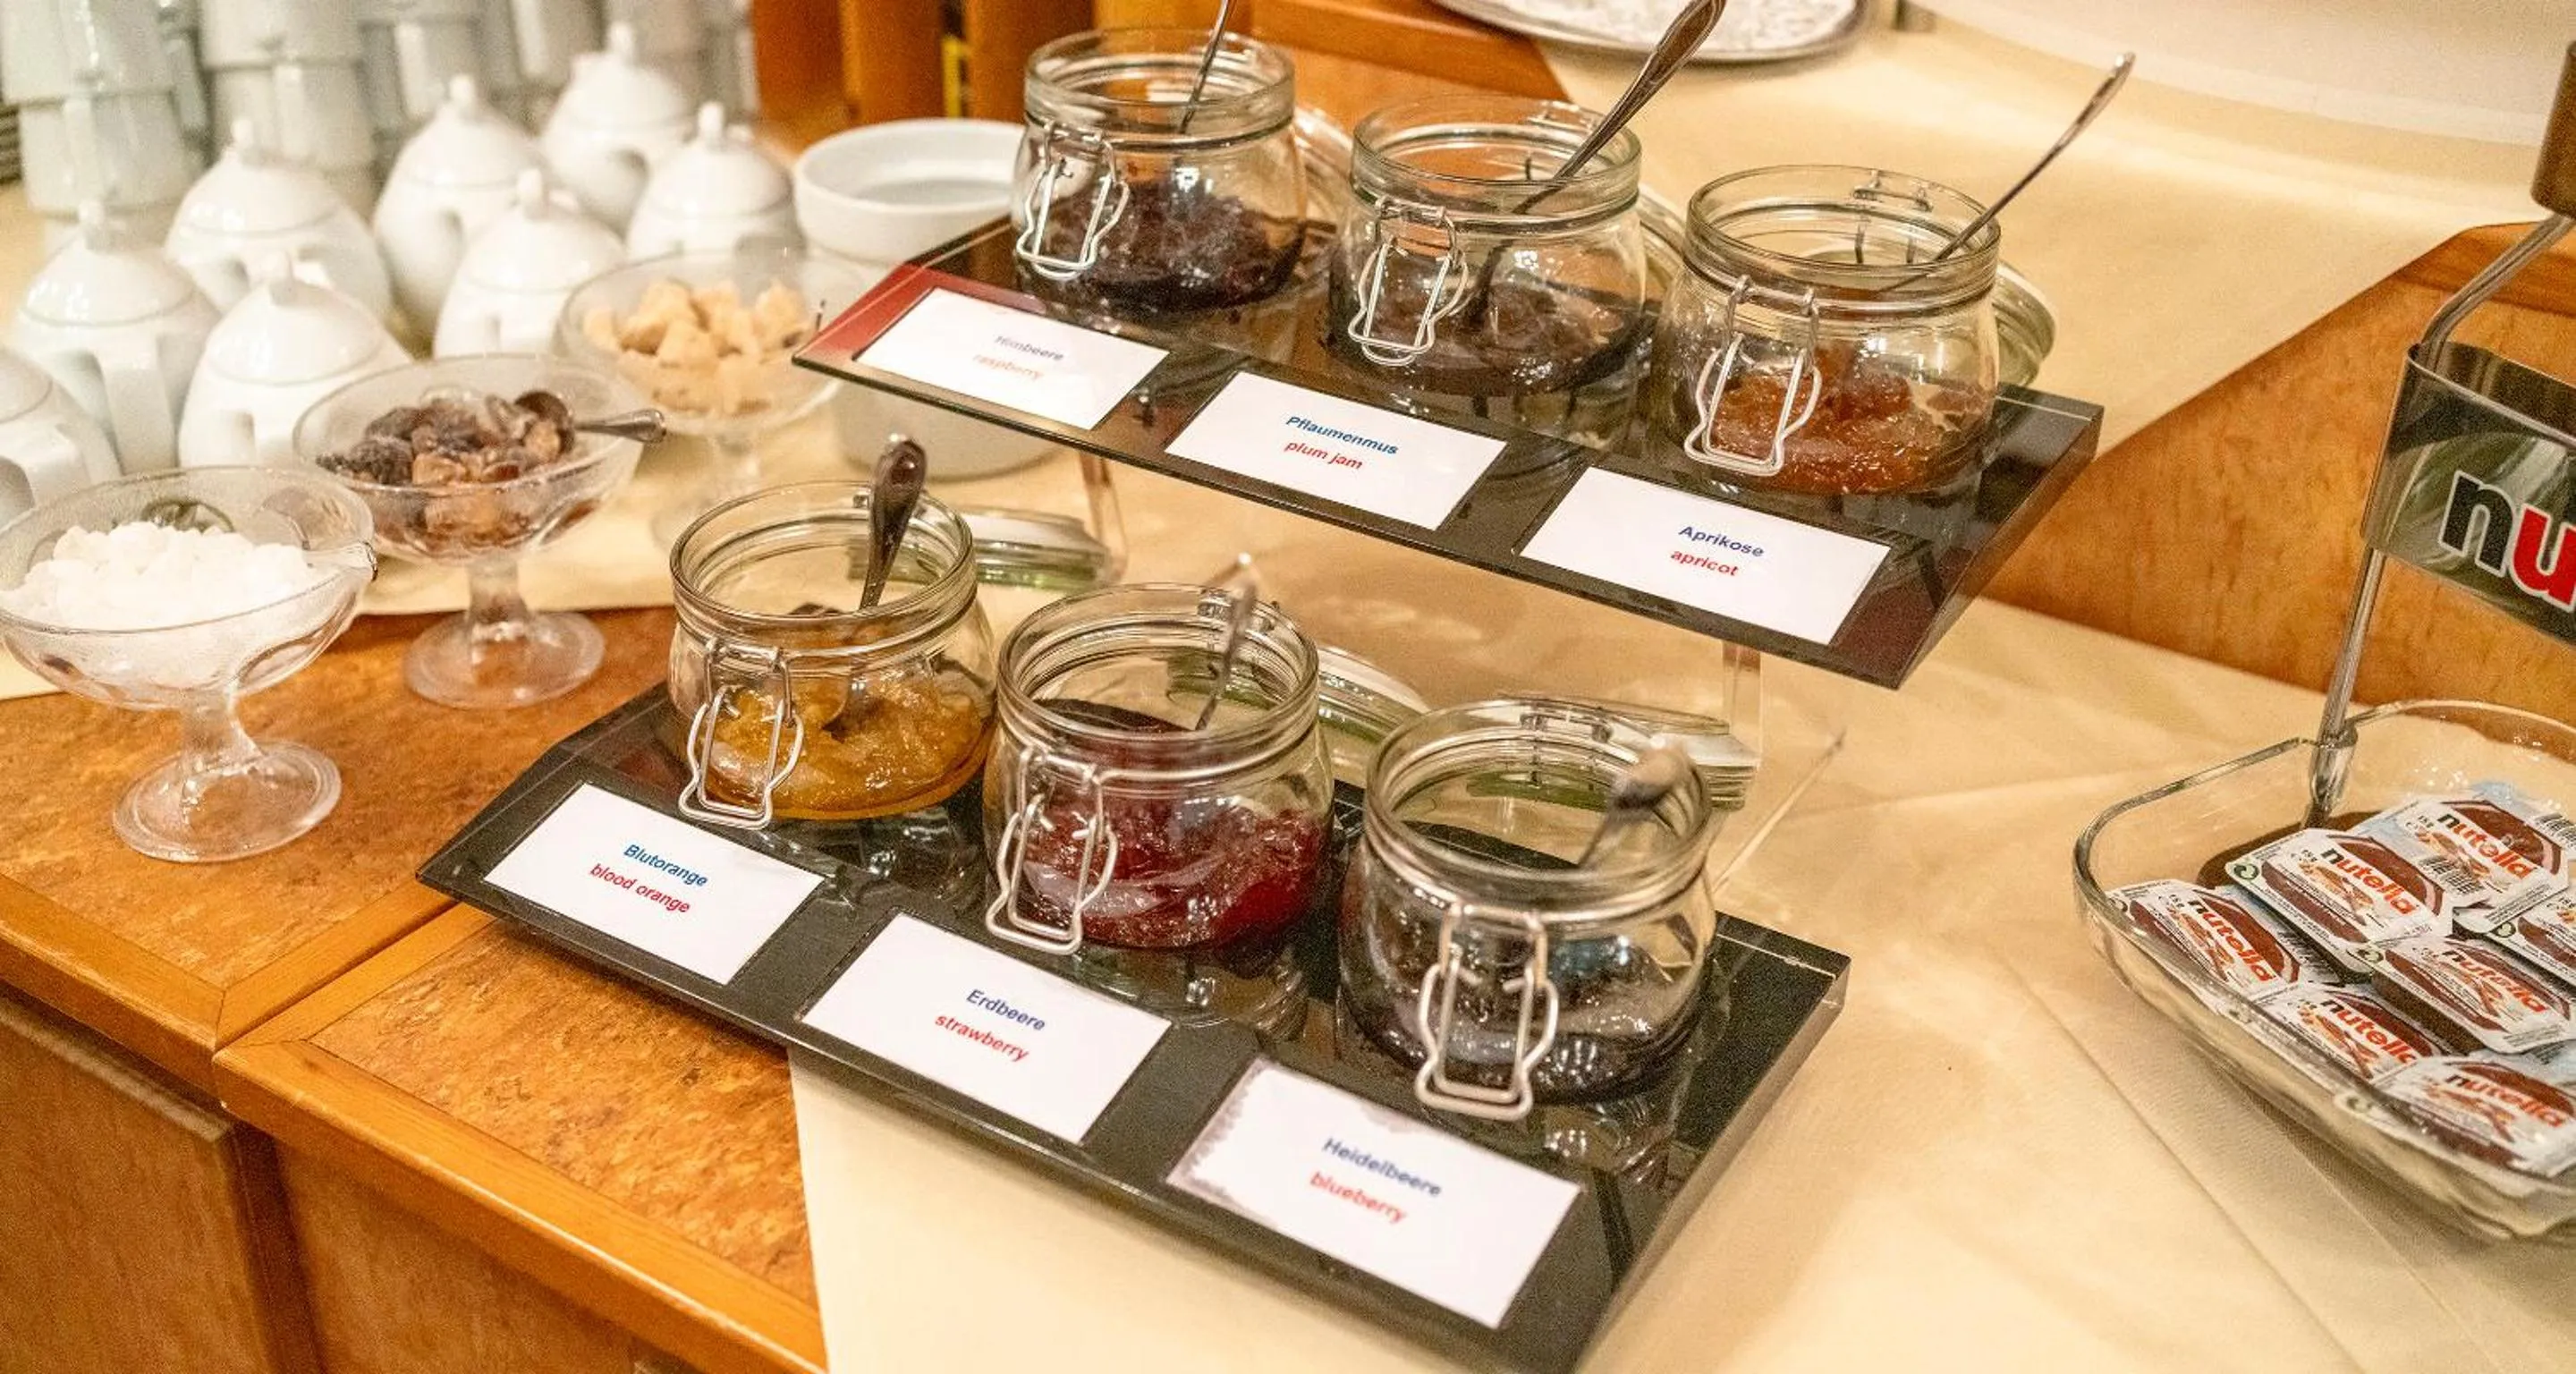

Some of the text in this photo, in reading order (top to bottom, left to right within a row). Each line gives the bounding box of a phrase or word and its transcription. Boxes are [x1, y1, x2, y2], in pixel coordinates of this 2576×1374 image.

[972, 354, 1045, 382] raspberry
[994, 335, 1064, 361] Himbeere
[1284, 442, 1363, 470] plum jam
[1285, 415, 1400, 454] Pflaumenmus
[1670, 550, 1739, 576] apricot
[1678, 525, 1765, 558] Aprikose
[623, 844, 708, 886] Blutorange
[2436, 813, 2533, 879] nutella
[589, 863, 691, 913] blood orange
[2320, 847, 2416, 916] nutella
[2188, 899, 2276, 982] nutella
[2442, 949, 2548, 1014] nutella
[965, 988, 1046, 1032] Erdbeere
[934, 1013, 1030, 1064] strawberry
[2445, 1074, 2567, 1128] nutella
[1322, 1137, 1443, 1197] Heidelbeere
[1309, 1171, 1407, 1224] blueberry
